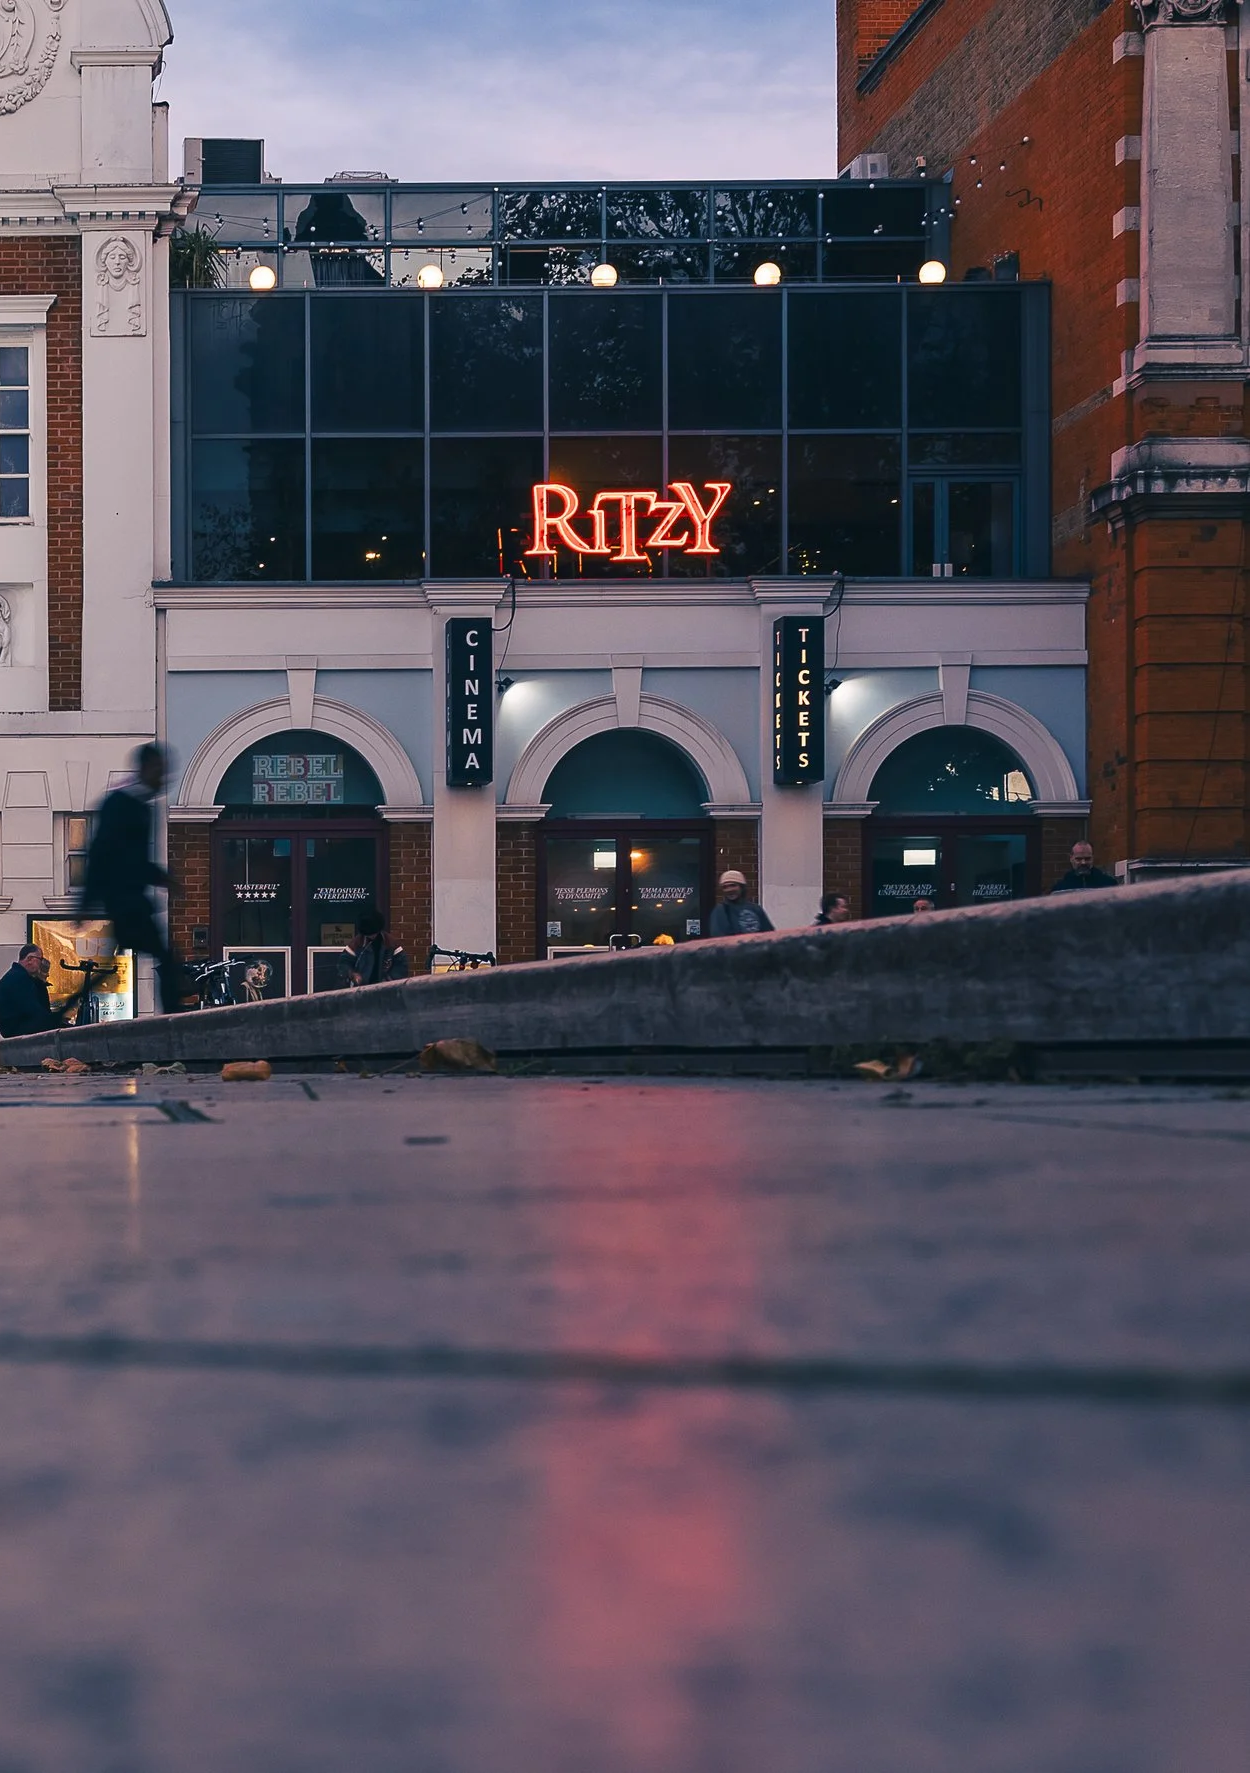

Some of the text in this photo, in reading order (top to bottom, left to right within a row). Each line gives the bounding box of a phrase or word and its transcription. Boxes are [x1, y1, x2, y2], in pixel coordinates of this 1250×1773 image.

[462, 630, 482, 769] CINEMA
[798, 628, 810, 768] TICKETS
[253, 755, 343, 778] REBEL
[253, 781, 343, 804] REBEL
